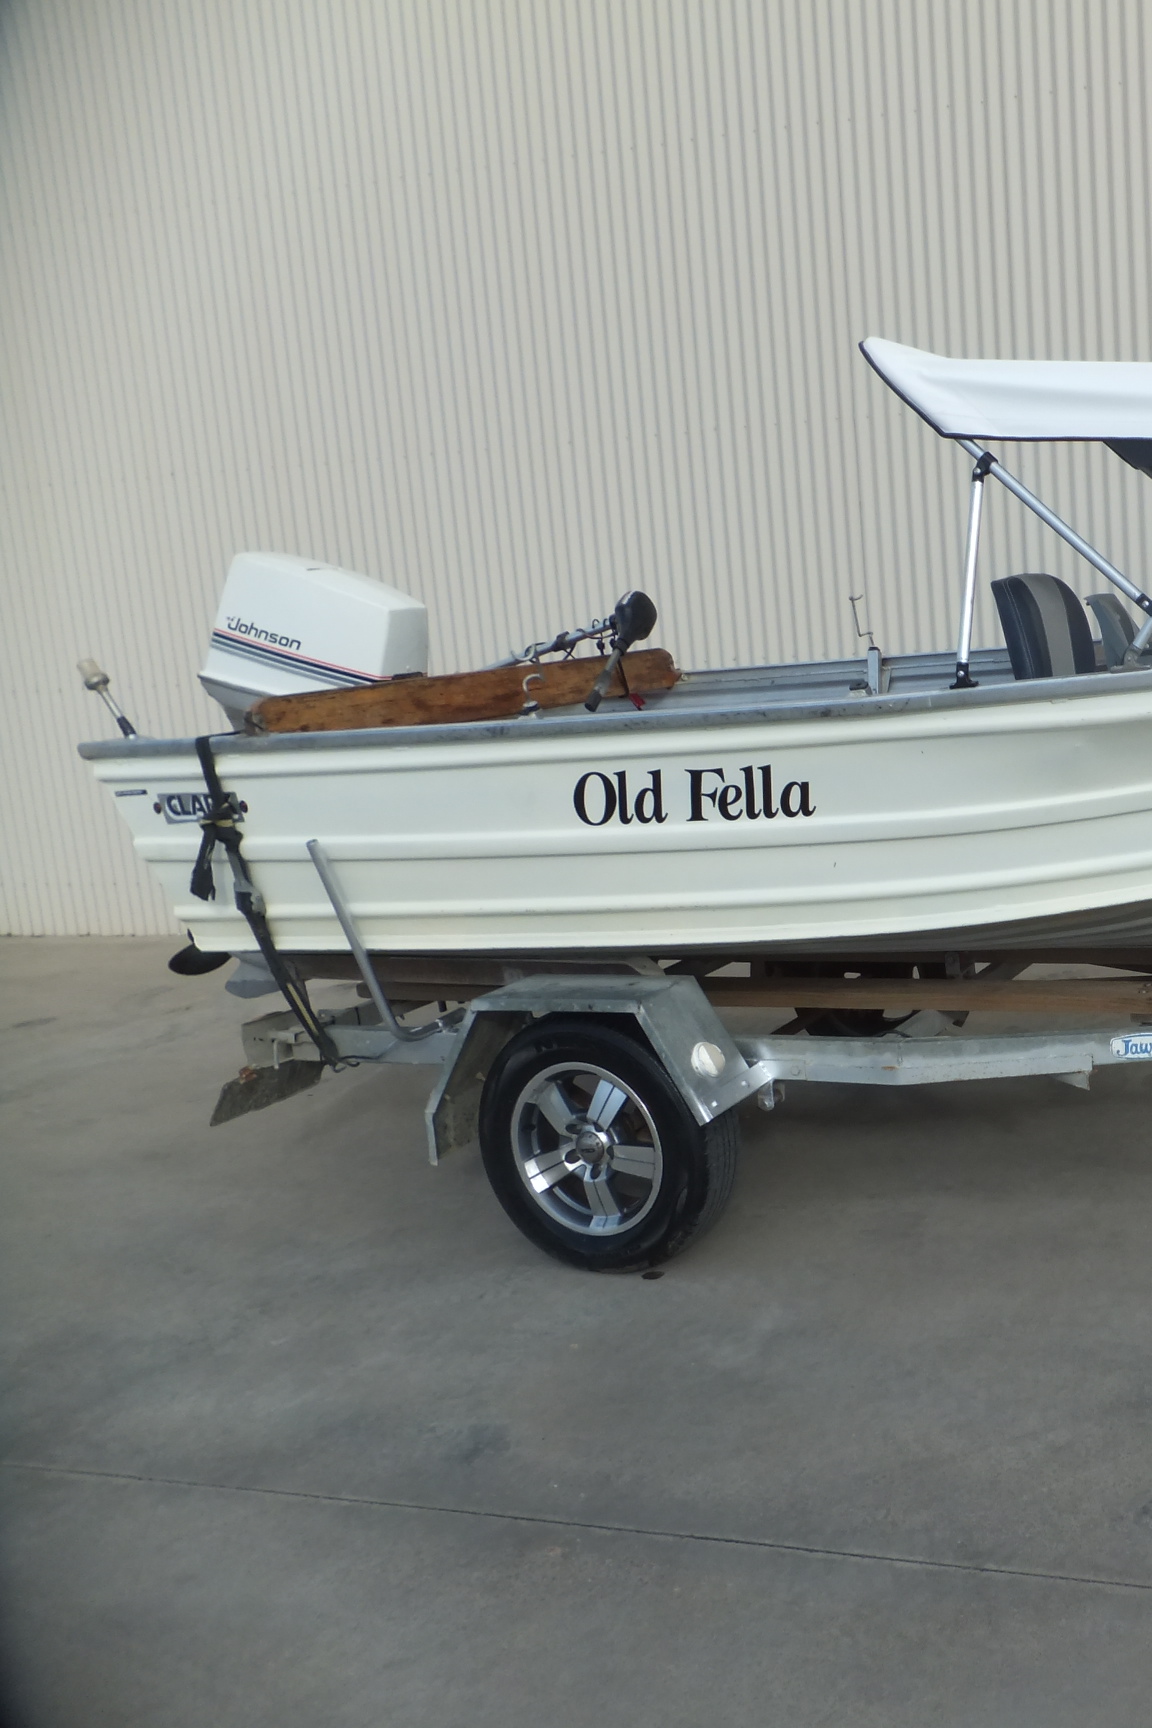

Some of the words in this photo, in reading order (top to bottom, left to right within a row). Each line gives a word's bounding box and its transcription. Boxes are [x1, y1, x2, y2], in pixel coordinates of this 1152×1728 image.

[227, 617, 302, 650] Johnson
[166, 794, 238, 816] CLA
[573, 768, 668, 826] Old
[684, 764, 817, 821] Fella
